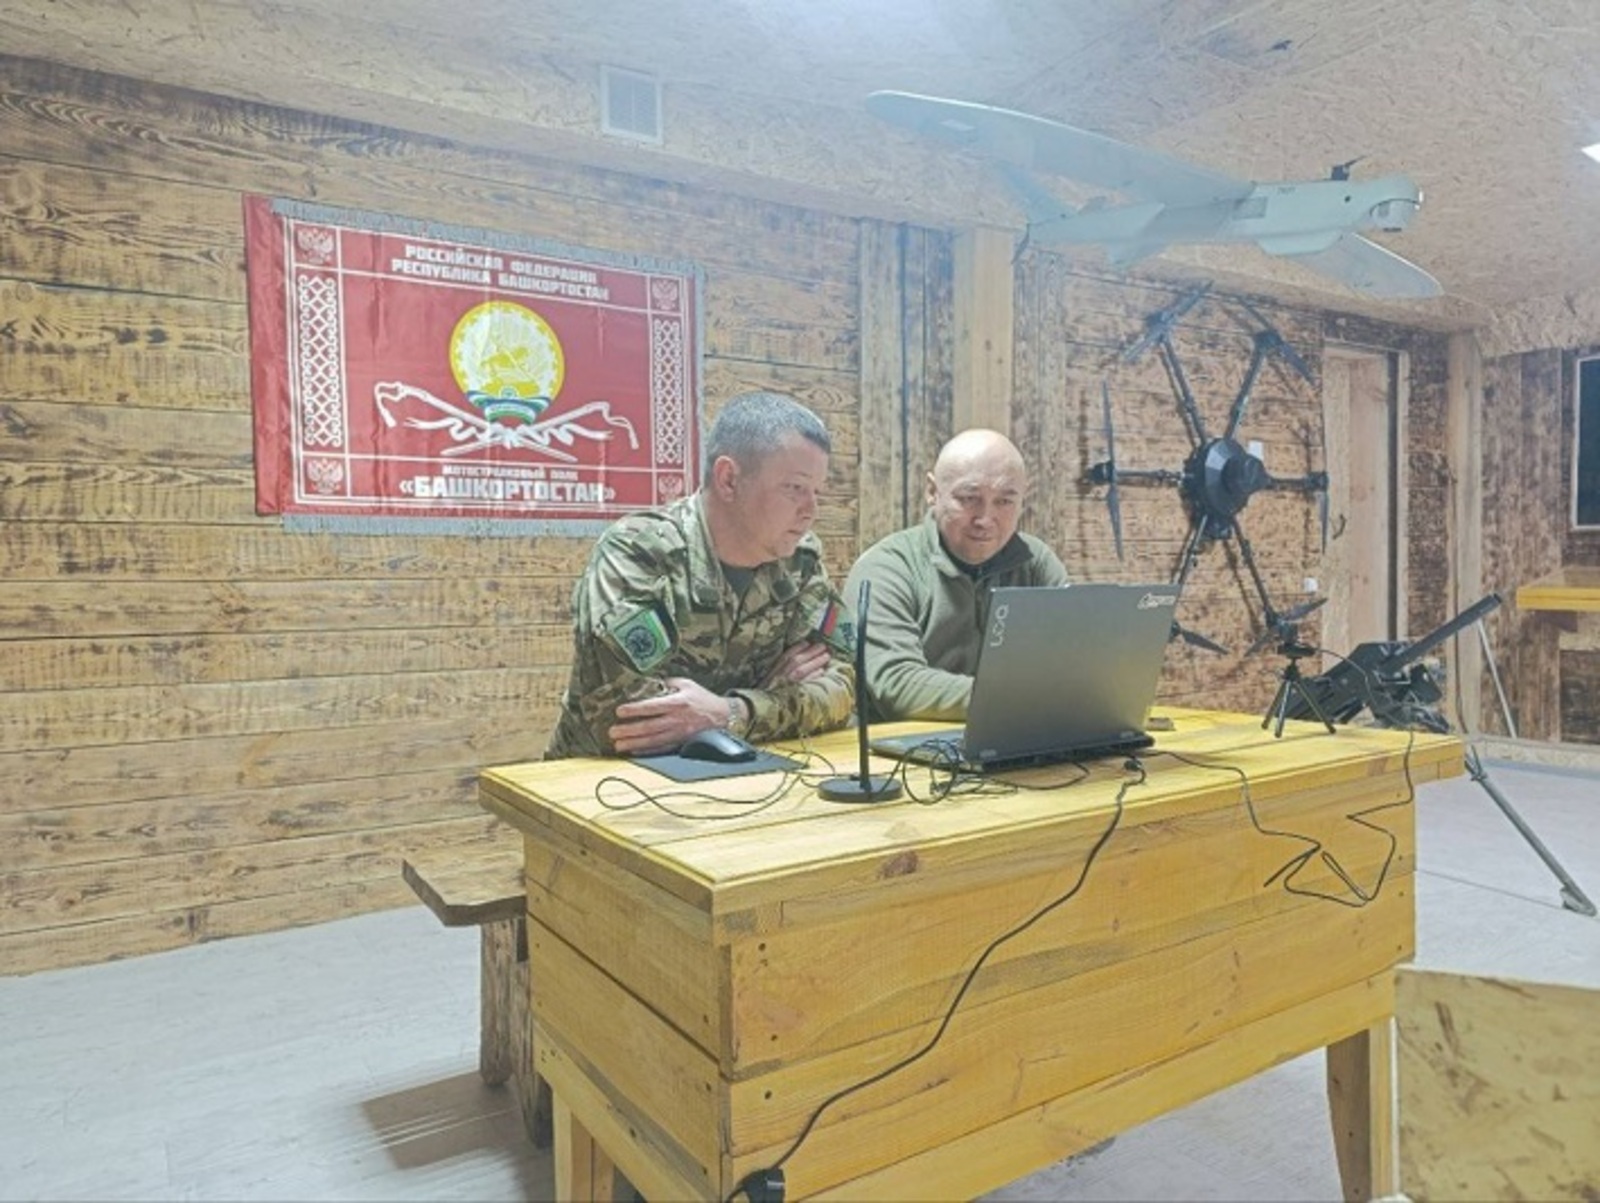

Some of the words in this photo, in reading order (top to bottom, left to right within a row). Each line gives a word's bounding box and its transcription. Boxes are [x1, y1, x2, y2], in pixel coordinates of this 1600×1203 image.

[392, 258, 491, 284] РЕСПУБЛИКА
[498, 272, 610, 300] БАШКОРТОСТАН
[405, 244, 503, 271] РОССИЙСКАЯ
[511, 260, 597, 284] ФЕДЕРАЦИЯ
[399, 475, 616, 502] «БАШКОРТОСТАН»
